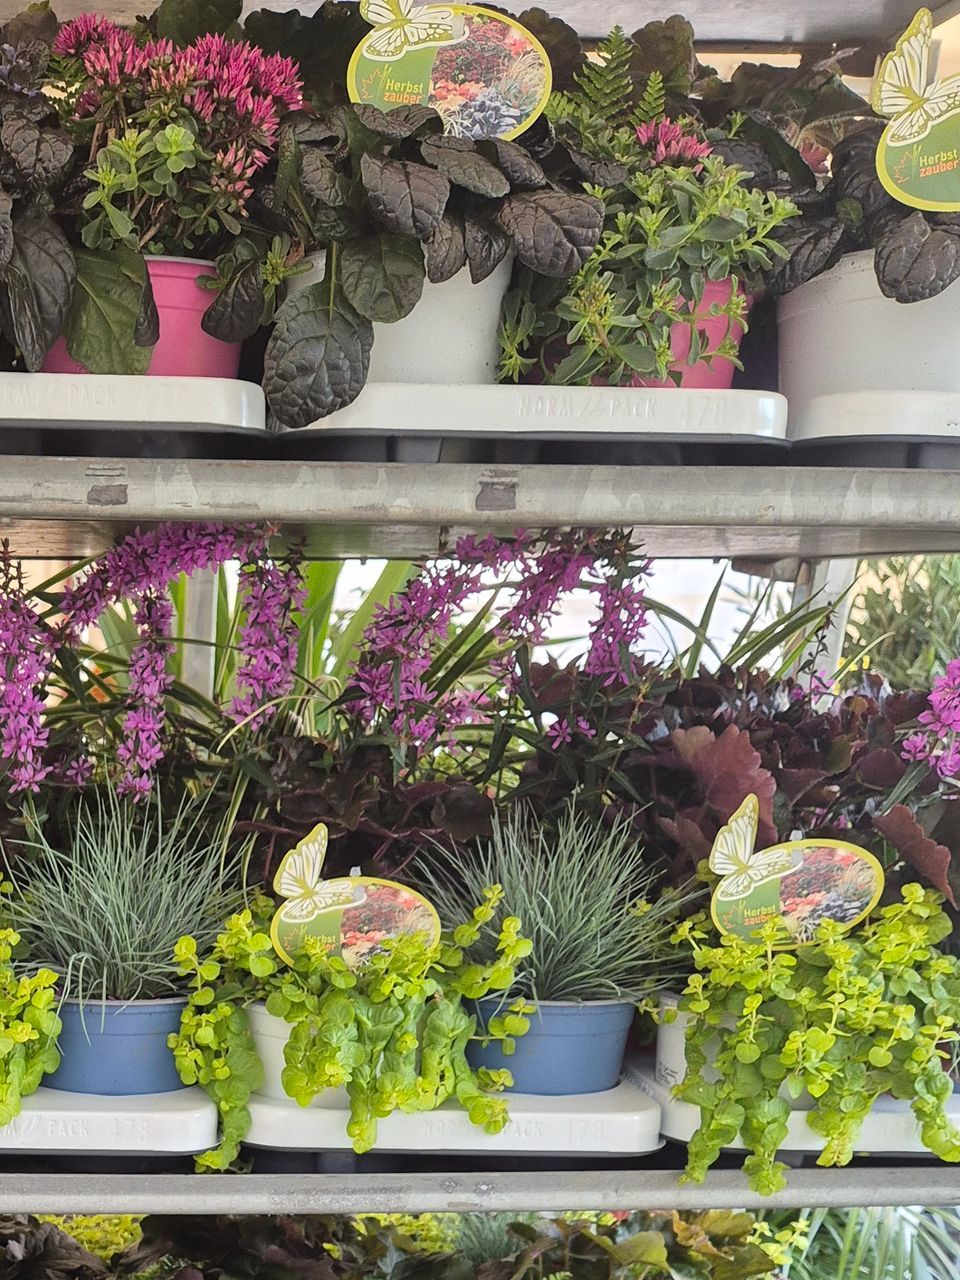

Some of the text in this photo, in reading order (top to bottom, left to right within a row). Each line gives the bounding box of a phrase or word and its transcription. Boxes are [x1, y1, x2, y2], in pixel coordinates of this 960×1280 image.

[385, 79, 424, 94] Herbst
[383, 91, 422, 104] zauber
[919, 150, 959, 168] Herbst
[919, 160, 960, 178] zauber
[744, 905, 776, 918] Herbst
